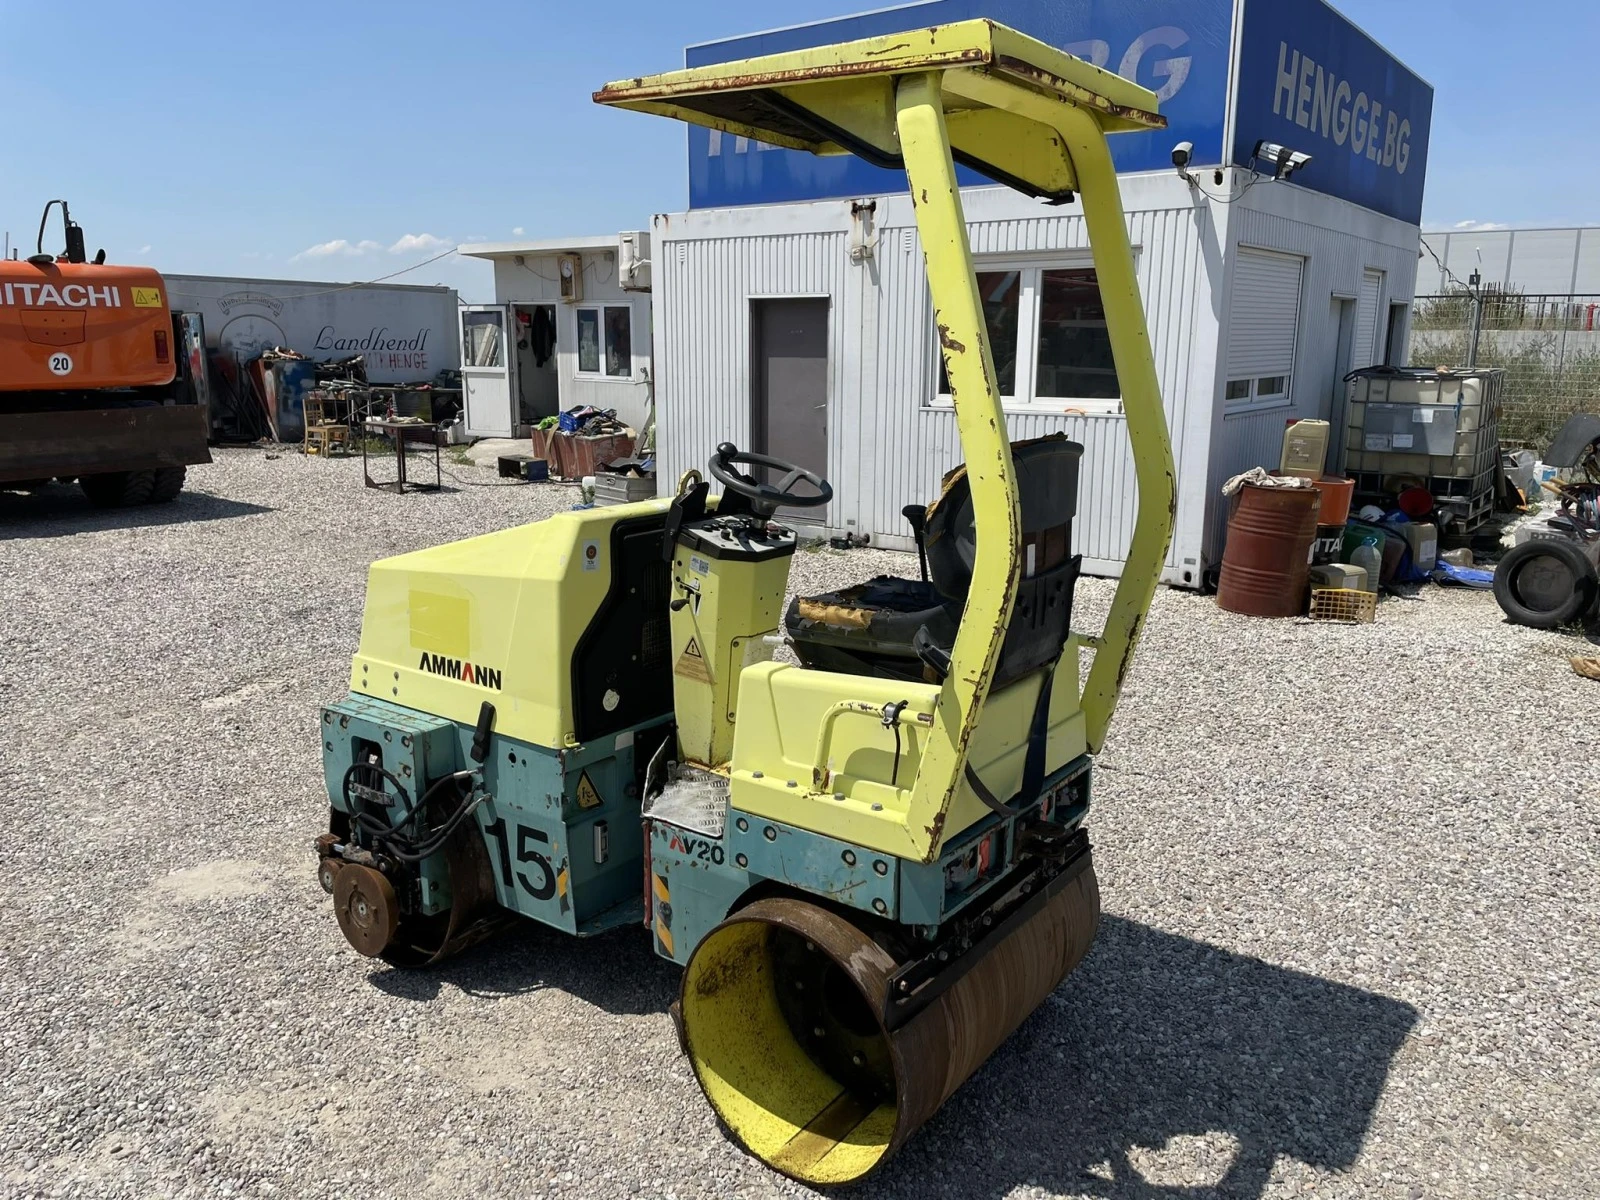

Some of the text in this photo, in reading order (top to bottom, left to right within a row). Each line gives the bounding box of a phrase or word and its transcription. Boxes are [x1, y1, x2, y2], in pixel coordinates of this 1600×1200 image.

[1272, 40, 1411, 174] HENGGE.BG
[0, 282, 122, 308] ITACHI
[313, 325, 431, 351] Landhendl
[53, 358, 69, 371] 20
[419, 651, 502, 691] AMMANN
[485, 816, 557, 901] 15
